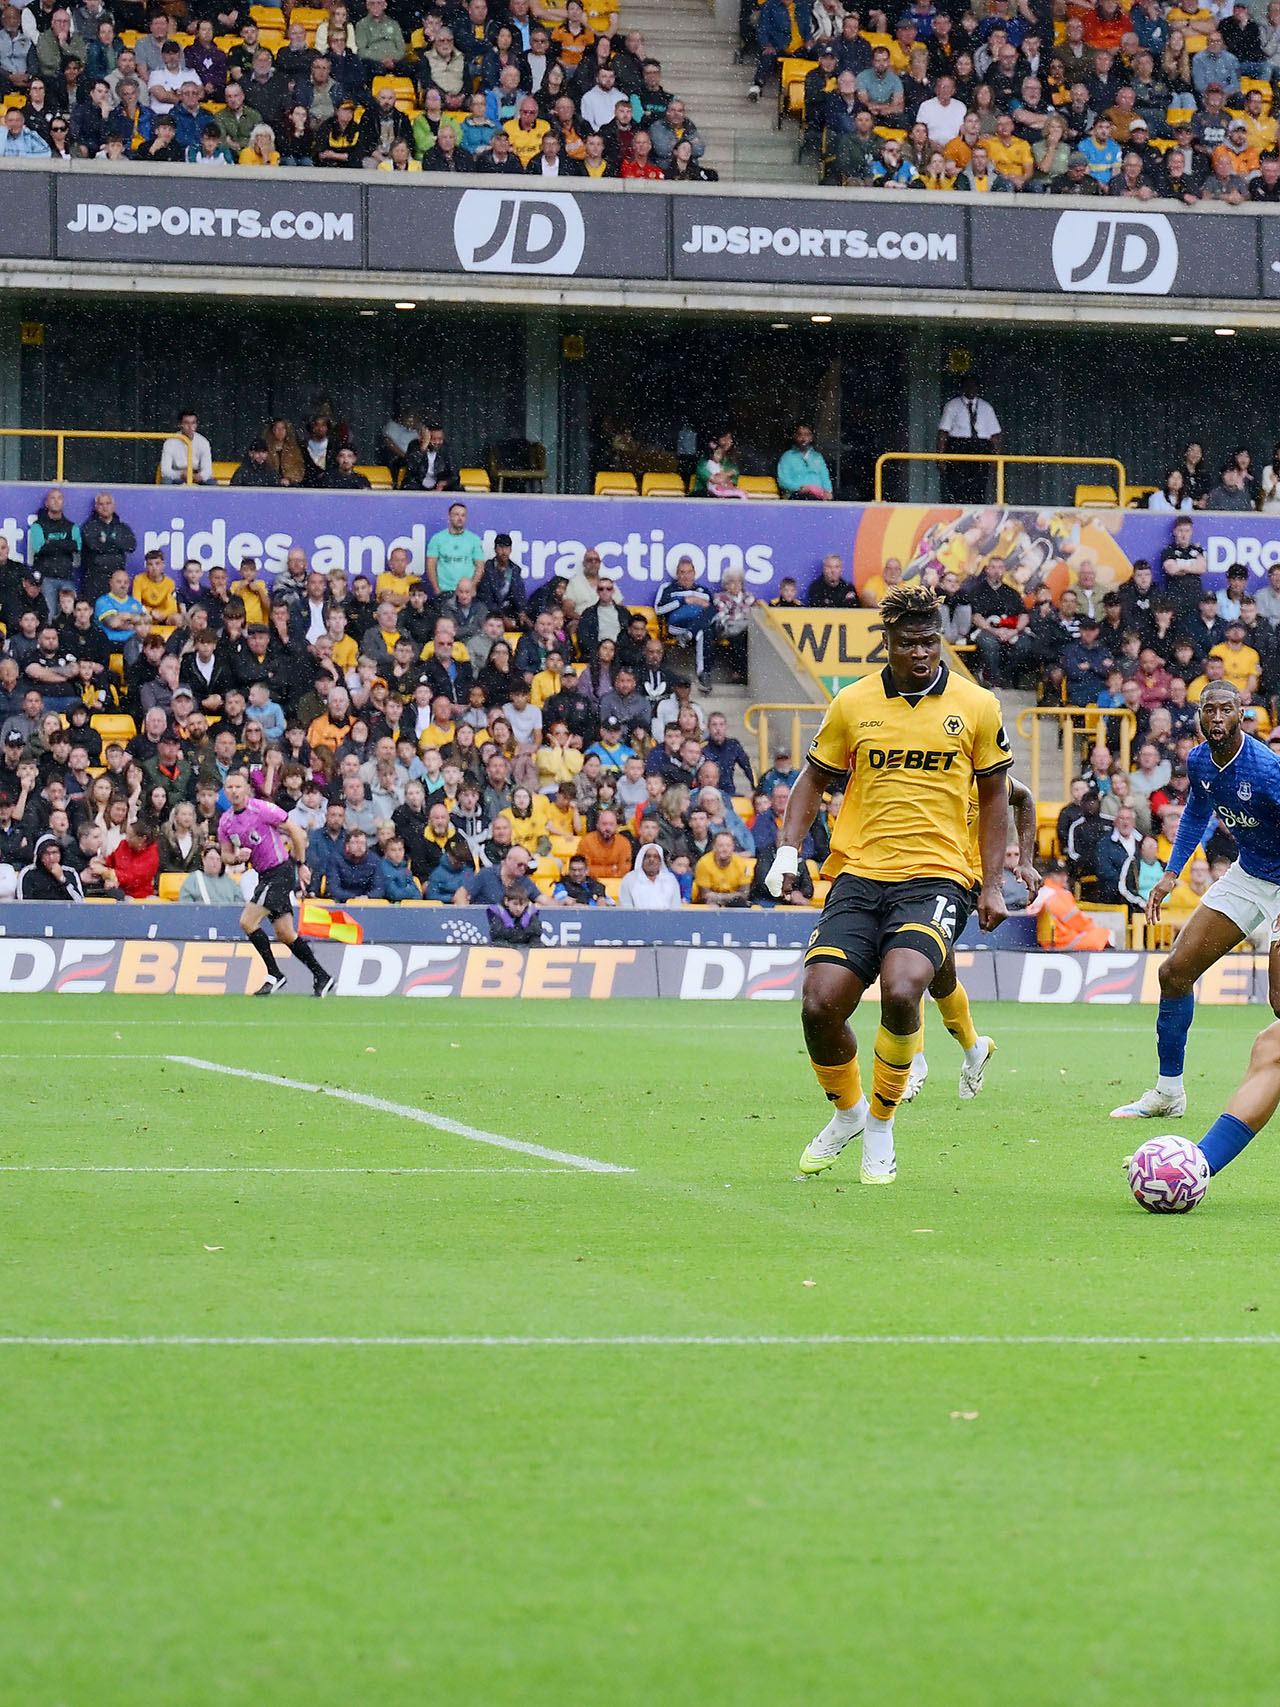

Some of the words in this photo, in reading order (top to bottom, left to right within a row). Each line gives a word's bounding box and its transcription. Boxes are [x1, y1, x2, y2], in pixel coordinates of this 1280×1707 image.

[67, 204, 353, 241] JDSPORTS.COM
[473, 200, 566, 264] JD
[682, 225, 957, 262] JDSPORTS.COM
[1071, 221, 1160, 284] JD
[144, 518, 292, 576] rides
[312, 524, 426, 577] and
[481, 529, 774, 586] ttractions
[869, 749, 957, 771] DEBET
[336, 944, 637, 999] DEBET
